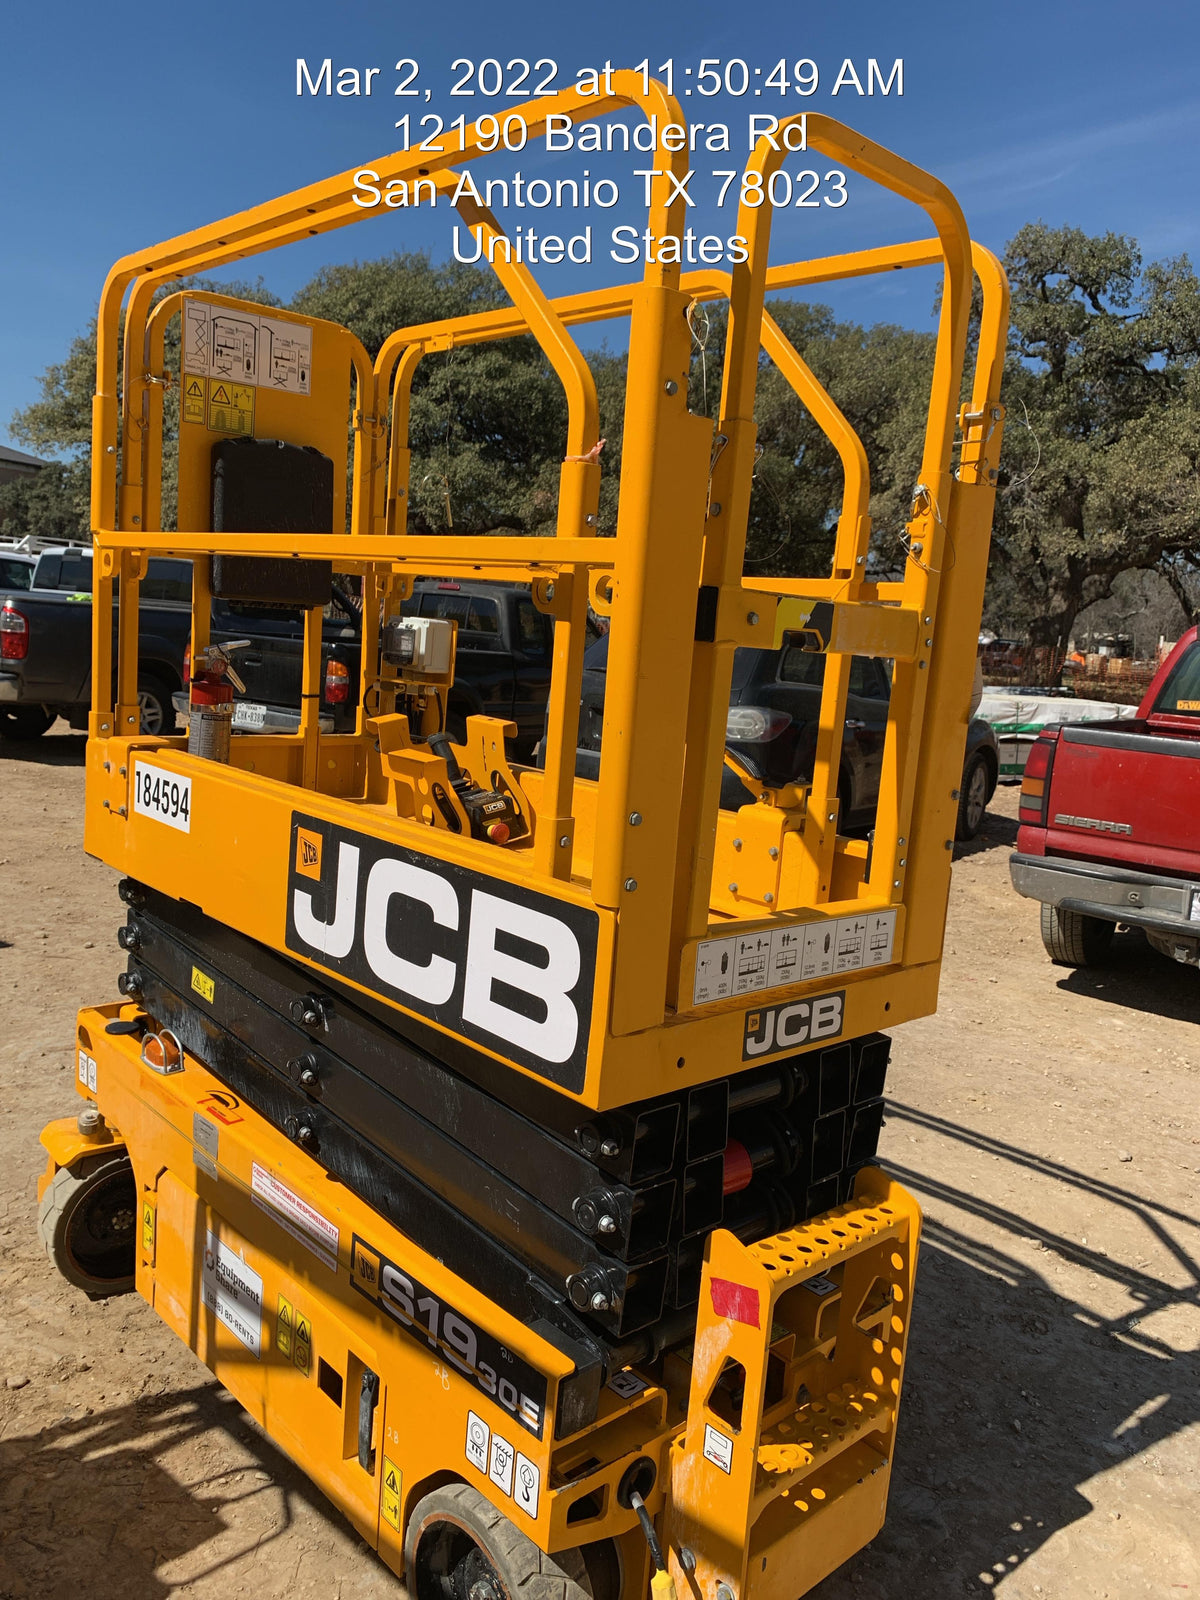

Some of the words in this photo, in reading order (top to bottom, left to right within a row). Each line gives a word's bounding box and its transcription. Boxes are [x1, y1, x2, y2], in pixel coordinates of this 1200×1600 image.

[135, 771, 189, 822] 184594
[487, 801, 504, 812] JCB
[1054, 813, 1133, 836] SIERRA
[302, 840, 318, 865] JCB
[294, 841, 581, 1064] JCB
[746, 996, 842, 1055] JCB
[297, 1201, 338, 1238] RESPONSIBILITY
[215, 1269, 238, 1300] Share
[216, 1255, 260, 1306] Equipment
[360, 1256, 376, 1281] JCB
